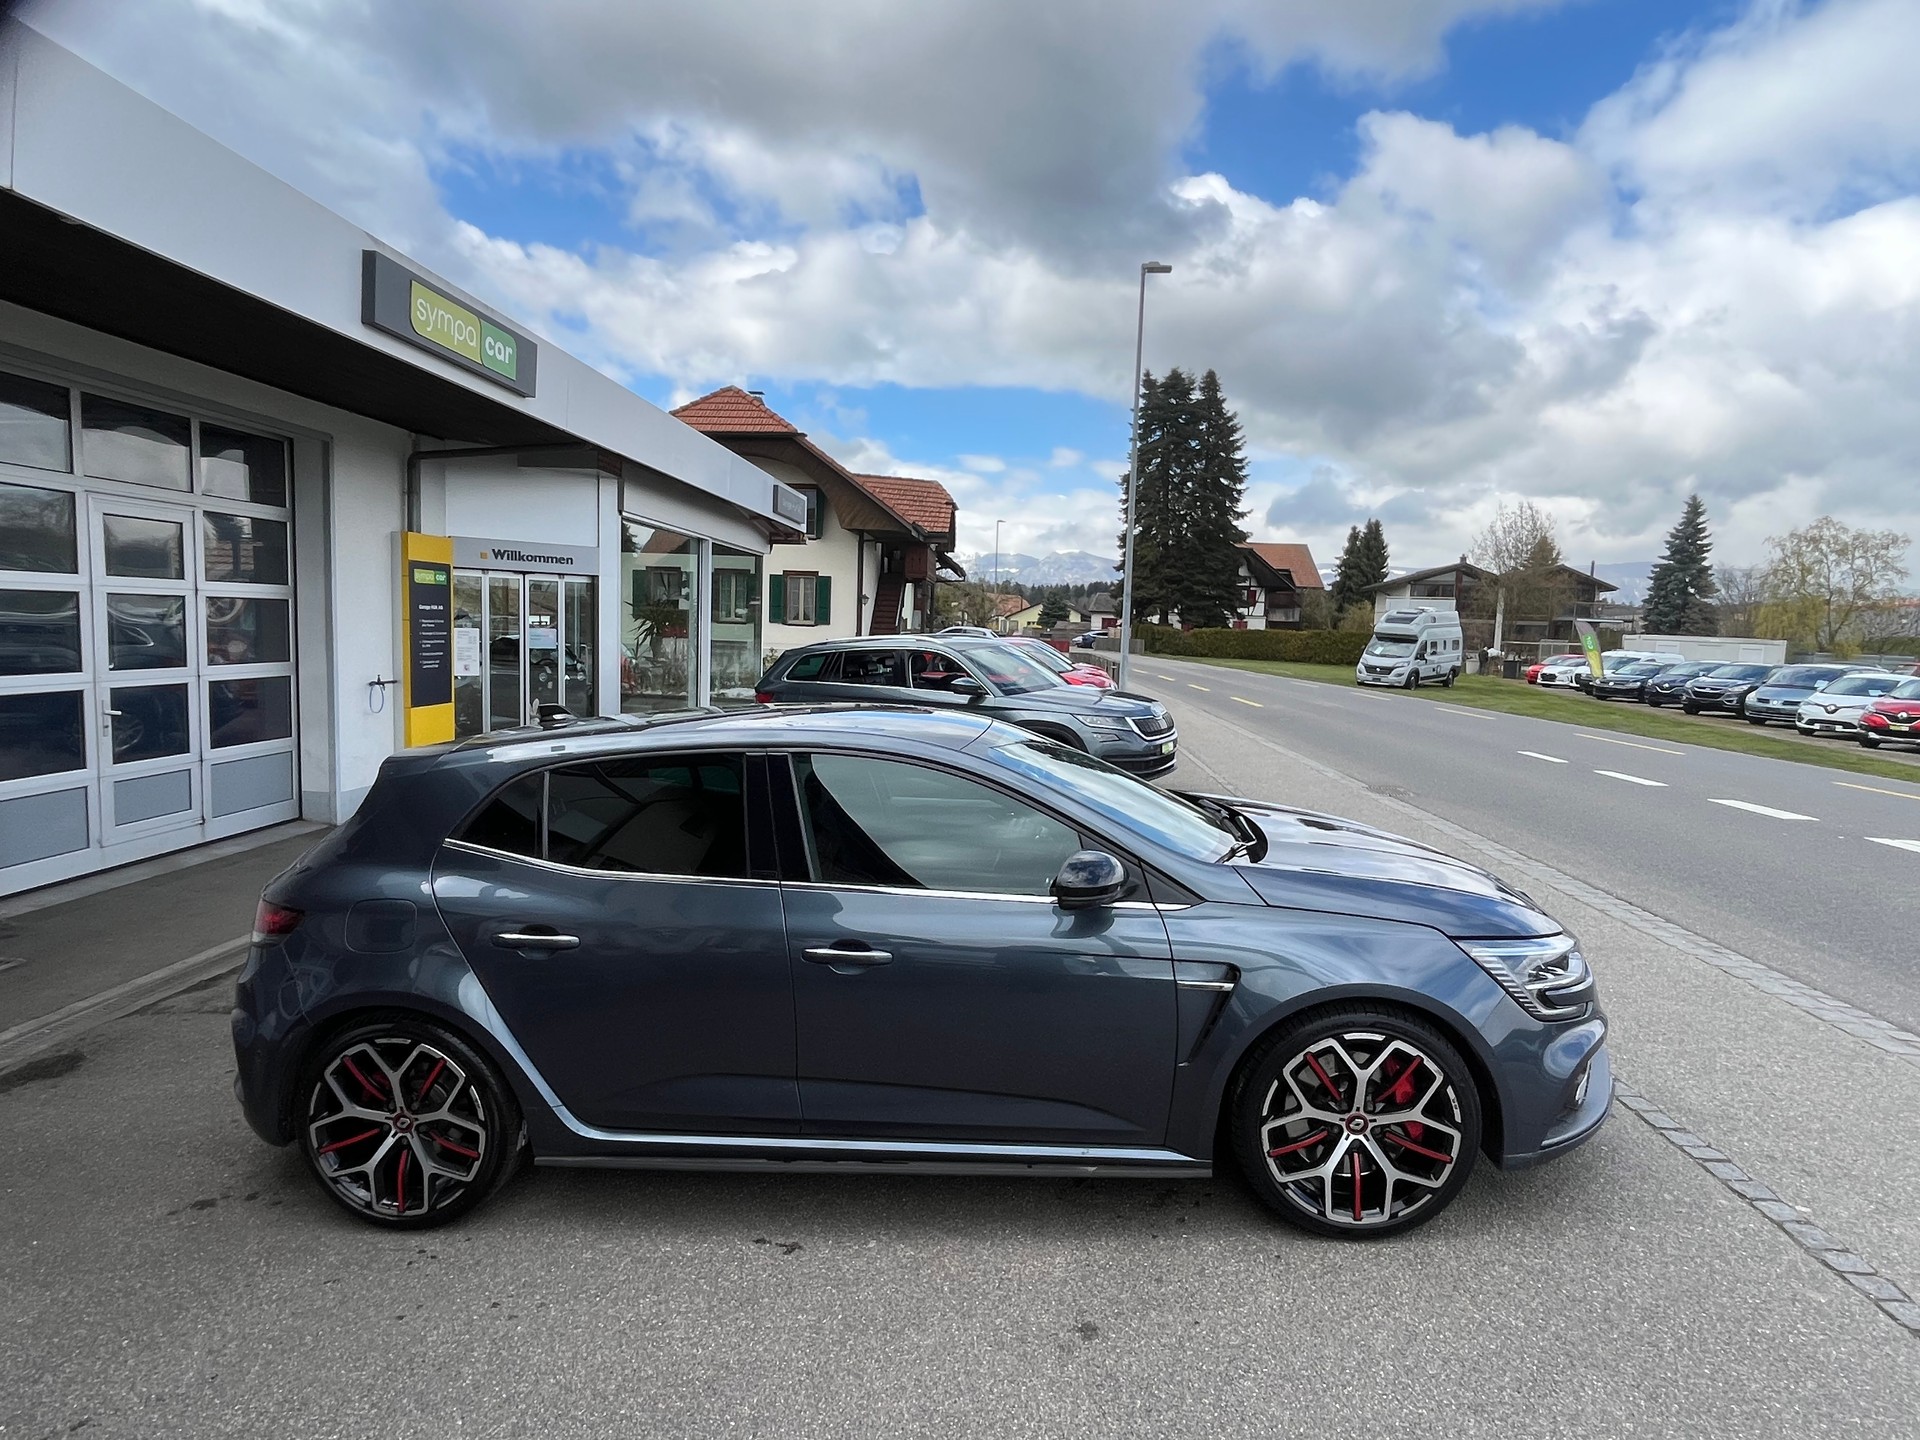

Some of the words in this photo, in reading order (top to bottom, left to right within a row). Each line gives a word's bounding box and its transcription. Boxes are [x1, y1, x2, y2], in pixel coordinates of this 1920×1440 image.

[416, 298, 477, 348] sympa
[485, 335, 513, 364] car
[492, 548, 574, 565] Willkommen
